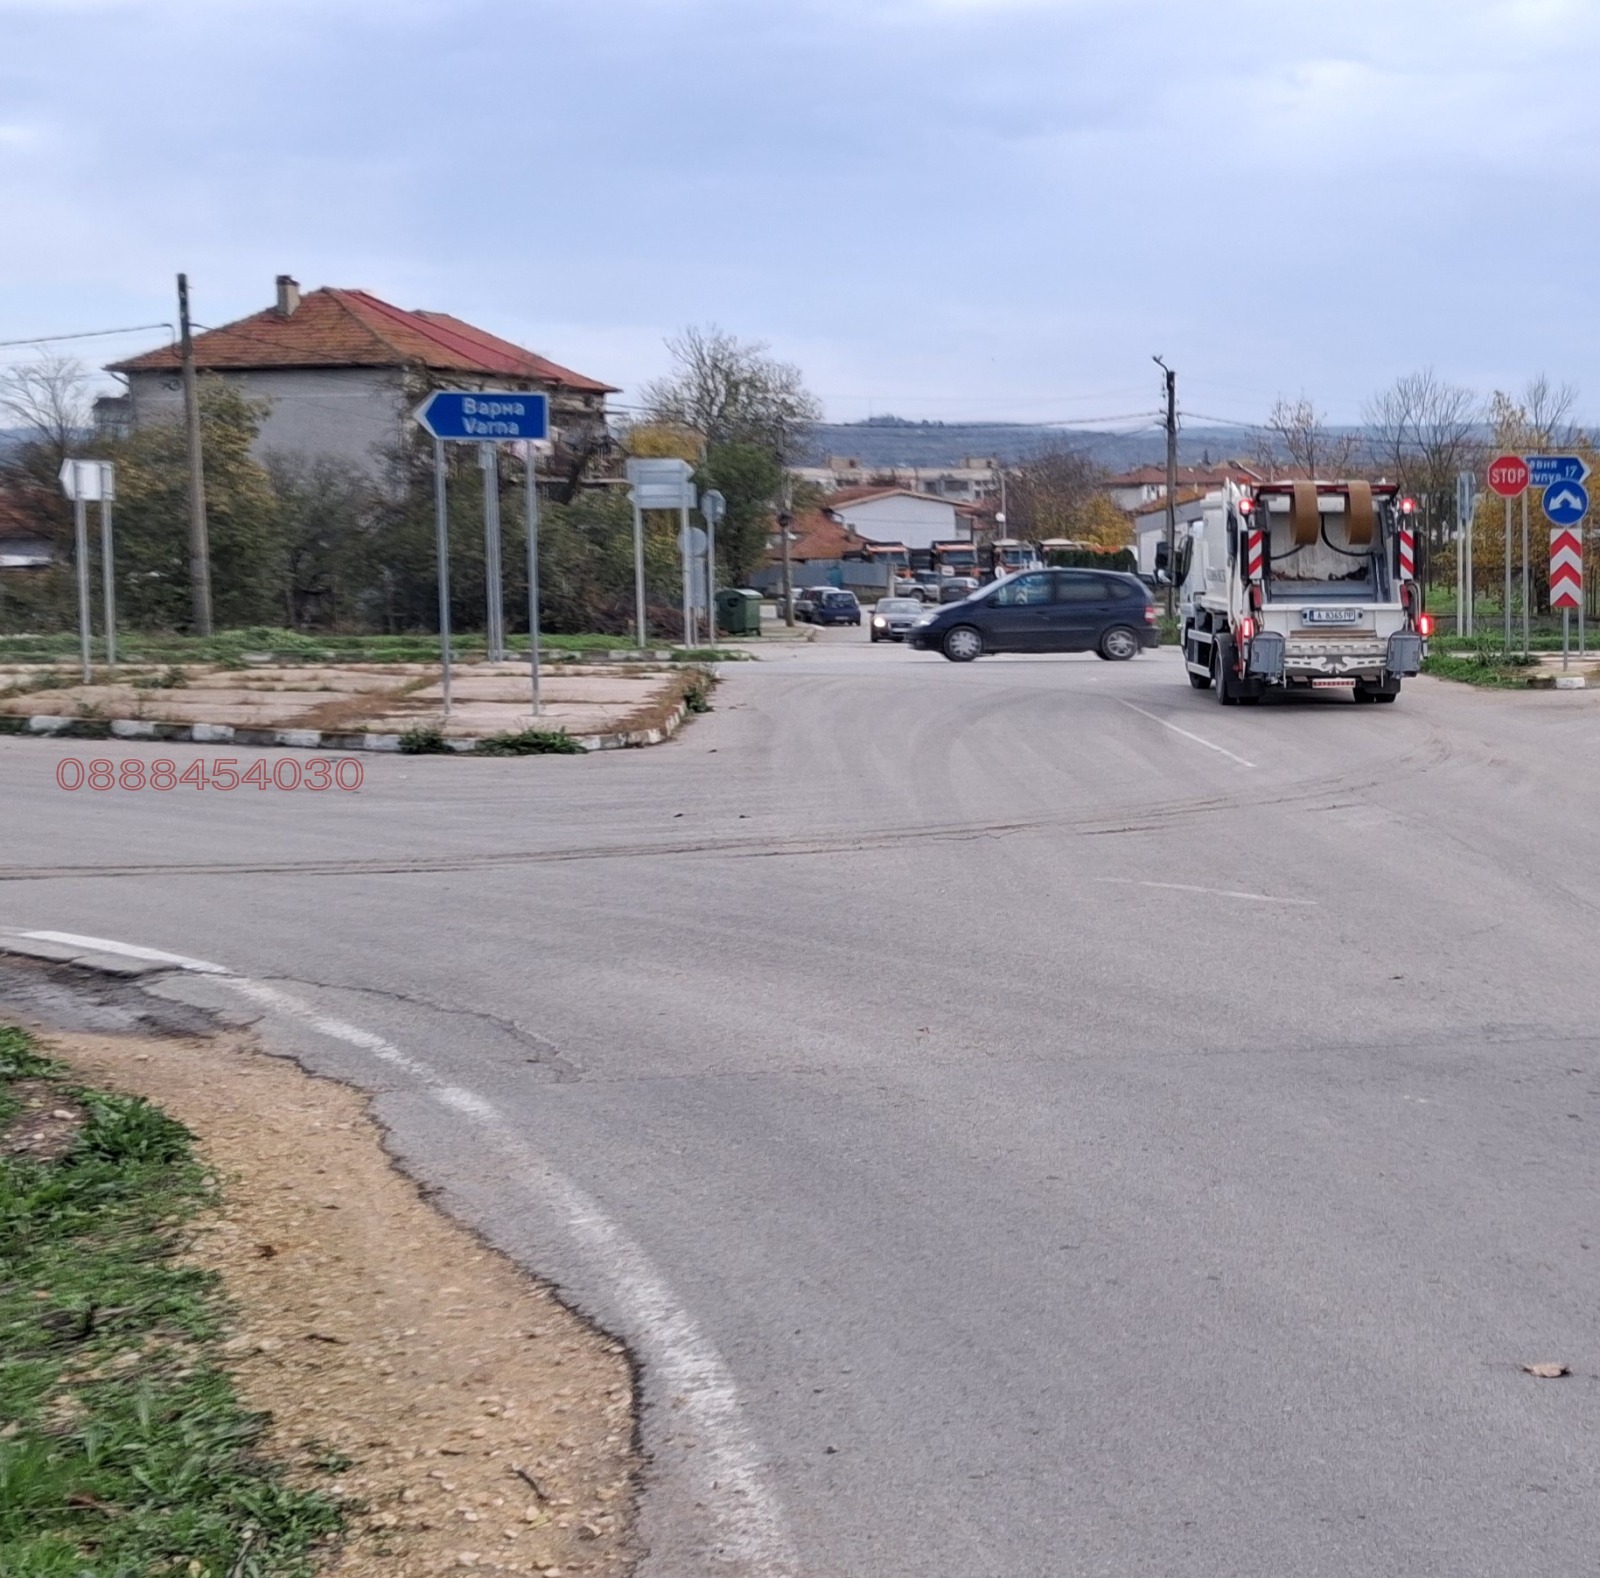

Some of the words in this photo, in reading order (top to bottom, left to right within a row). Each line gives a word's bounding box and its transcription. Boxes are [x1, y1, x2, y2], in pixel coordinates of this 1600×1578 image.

[461, 397, 525, 419] Варна
[461, 416, 520, 435] Varna
[1491, 468, 1526, 484] STOP
[1565, 465, 1578, 478] 17
